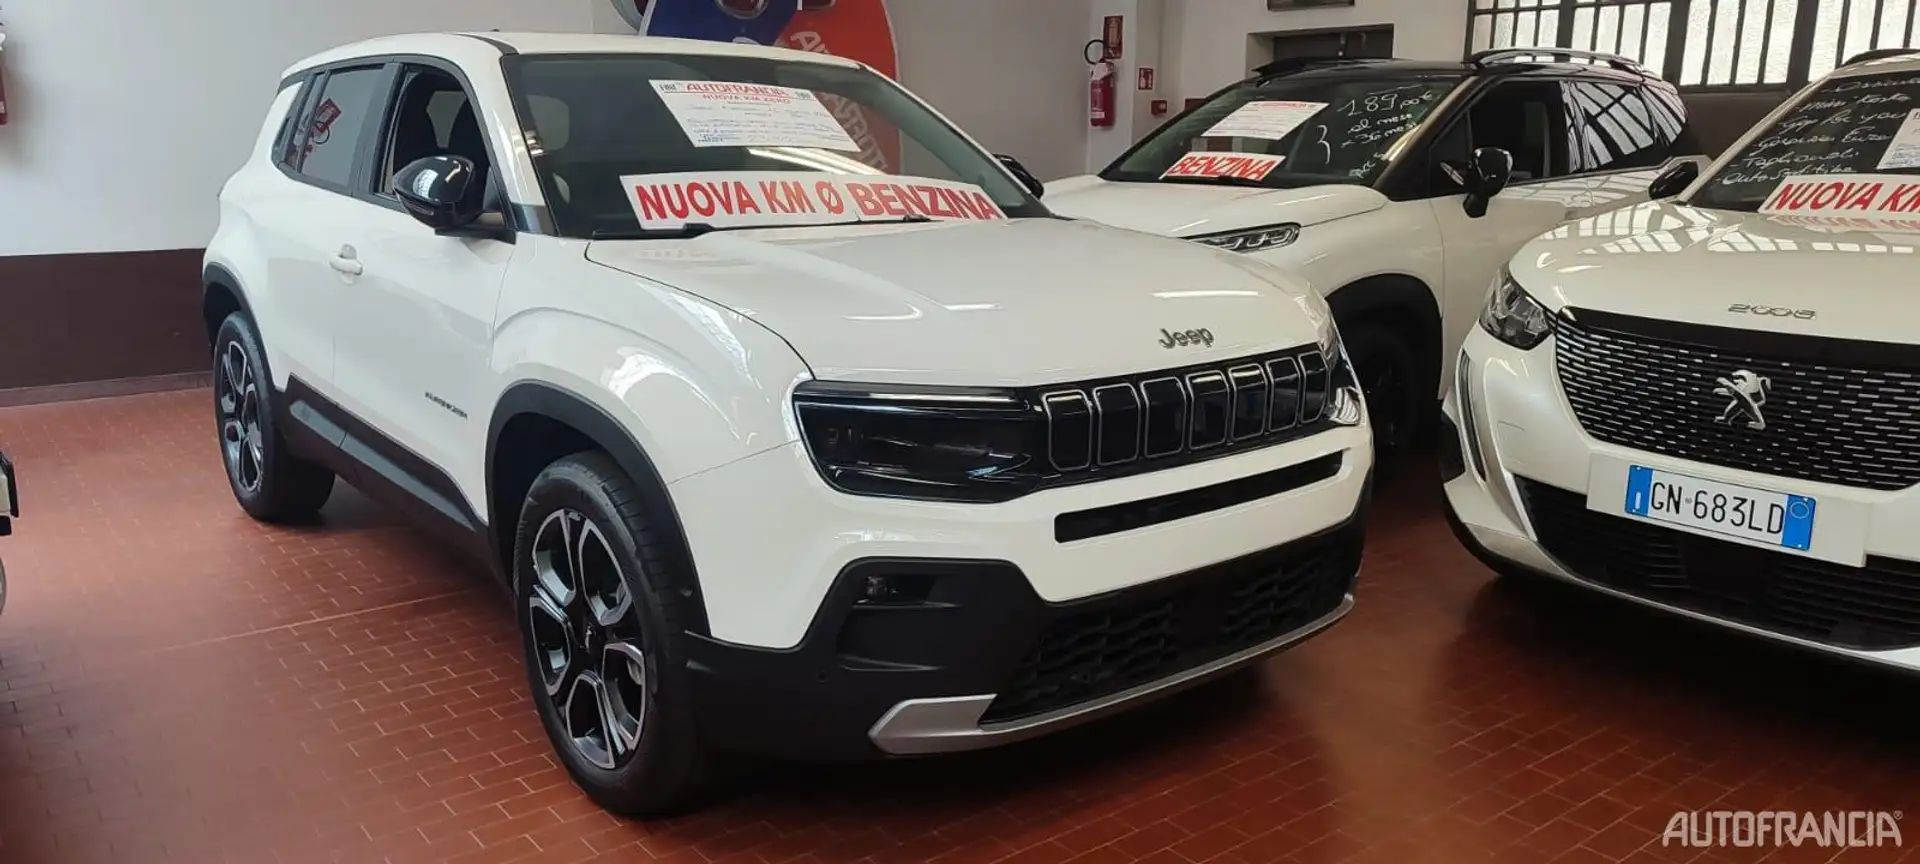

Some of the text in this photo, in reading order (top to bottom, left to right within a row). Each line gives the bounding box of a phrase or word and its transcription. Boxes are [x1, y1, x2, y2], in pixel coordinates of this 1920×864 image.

[1166, 155, 1278, 180] BENZINA
[636, 181, 760, 221] NUOVA
[759, 180, 817, 214] KM
[846, 183, 1001, 220] BENZINA
[1765, 182, 1884, 211] NUOVA
[1158, 327, 1214, 349] Jeep
